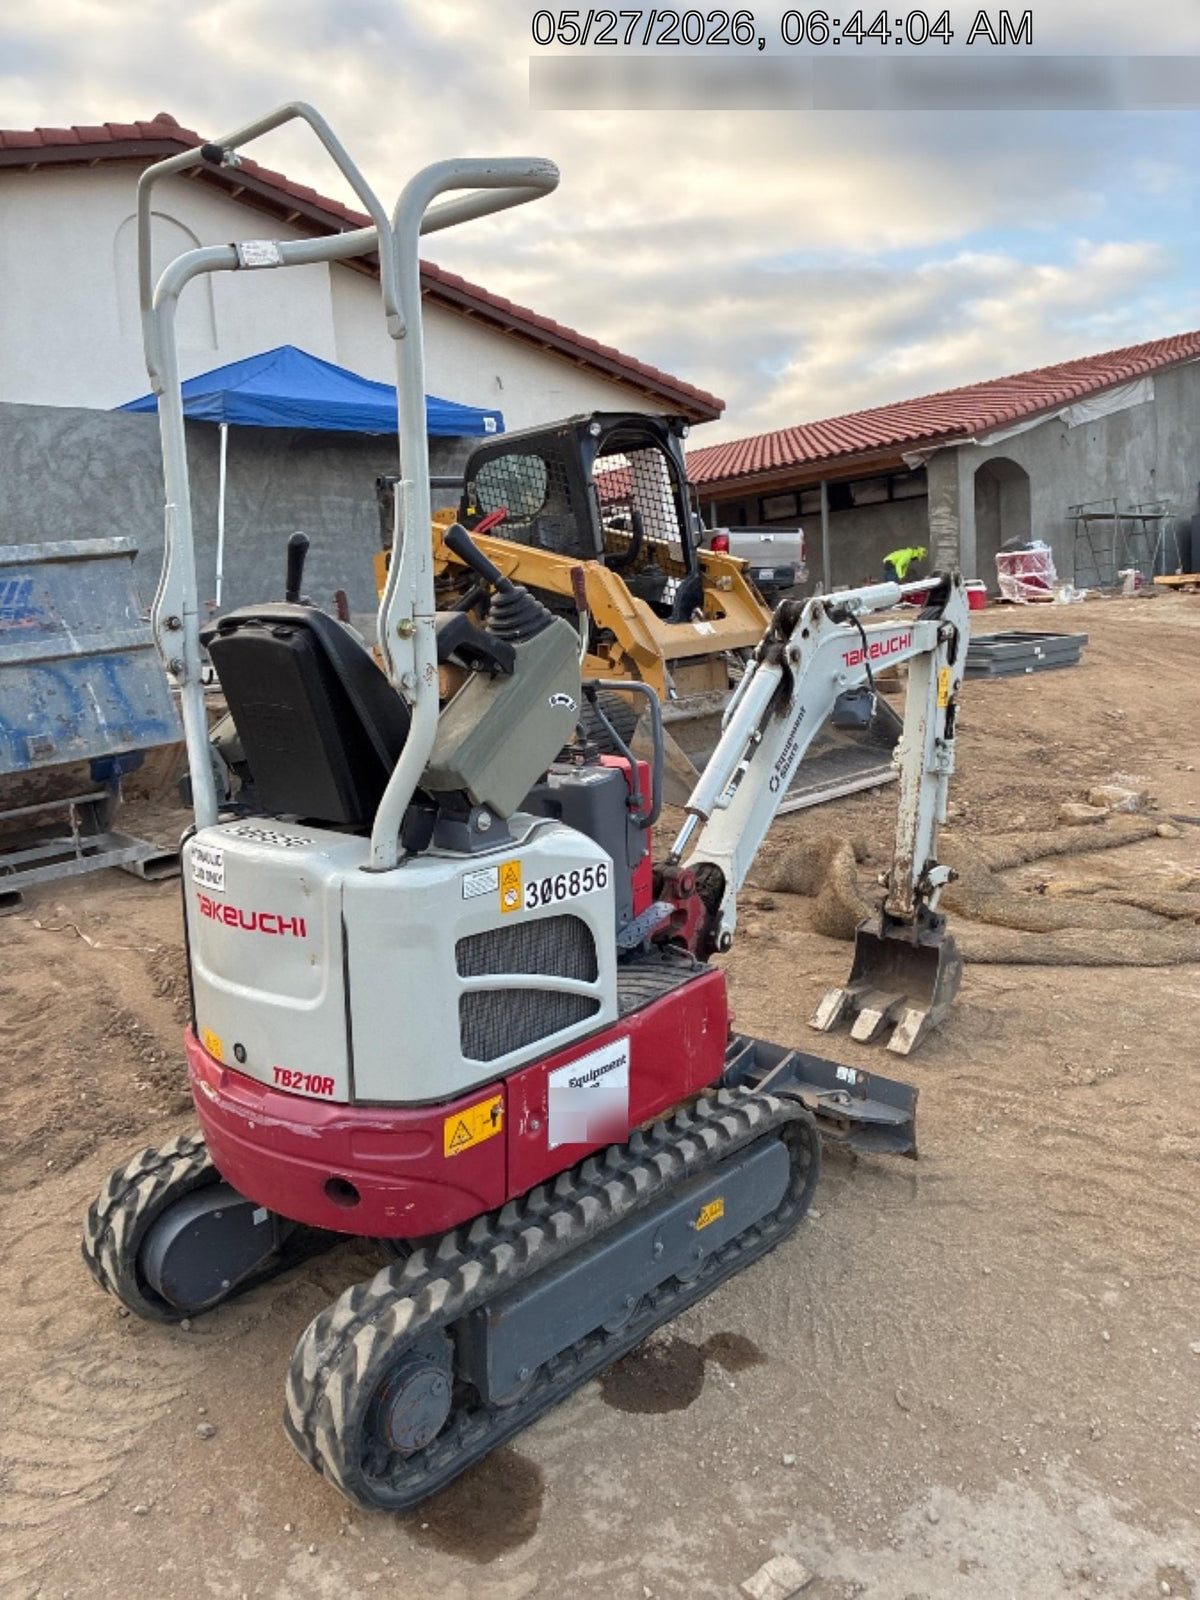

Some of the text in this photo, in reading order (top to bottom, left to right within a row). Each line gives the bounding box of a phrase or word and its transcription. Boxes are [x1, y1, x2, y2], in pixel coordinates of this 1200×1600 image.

[774, 705, 807, 772] Equipment
[780, 743, 799, 779] Share
[525, 863, 608, 909] 306856
[273, 1066, 335, 1096] TB210R
[568, 1054, 627, 1089] Equipment
